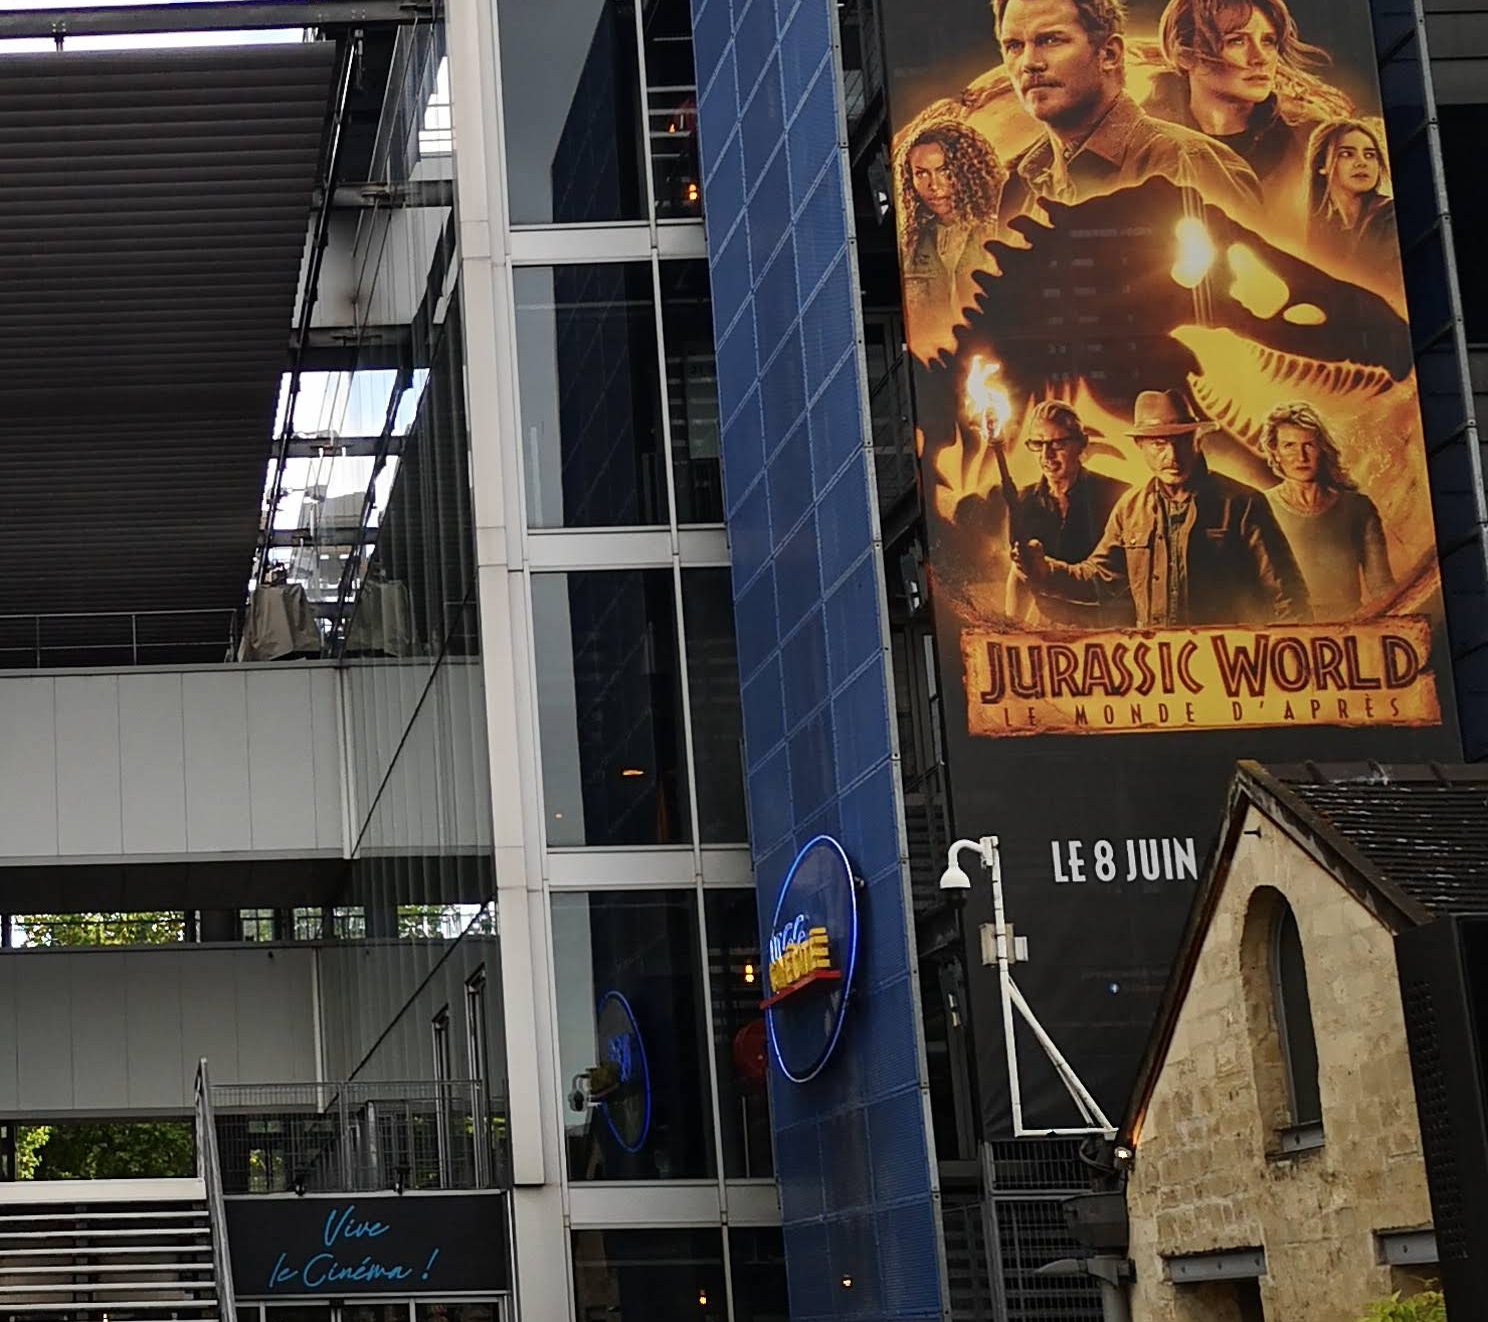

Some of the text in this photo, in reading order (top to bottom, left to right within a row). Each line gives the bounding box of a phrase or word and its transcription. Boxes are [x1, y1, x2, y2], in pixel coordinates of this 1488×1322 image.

[980, 634, 1419, 705] JURASSIC WORLD
[1004, 693, 1400, 727] LE MONDE D'APRÈS
[1051, 837, 1198, 883] LE 8 JUIN
[324, 1205, 390, 1246] Vive
[269, 1252, 299, 1287] le
[304, 1253, 412, 1287] Cinéma
